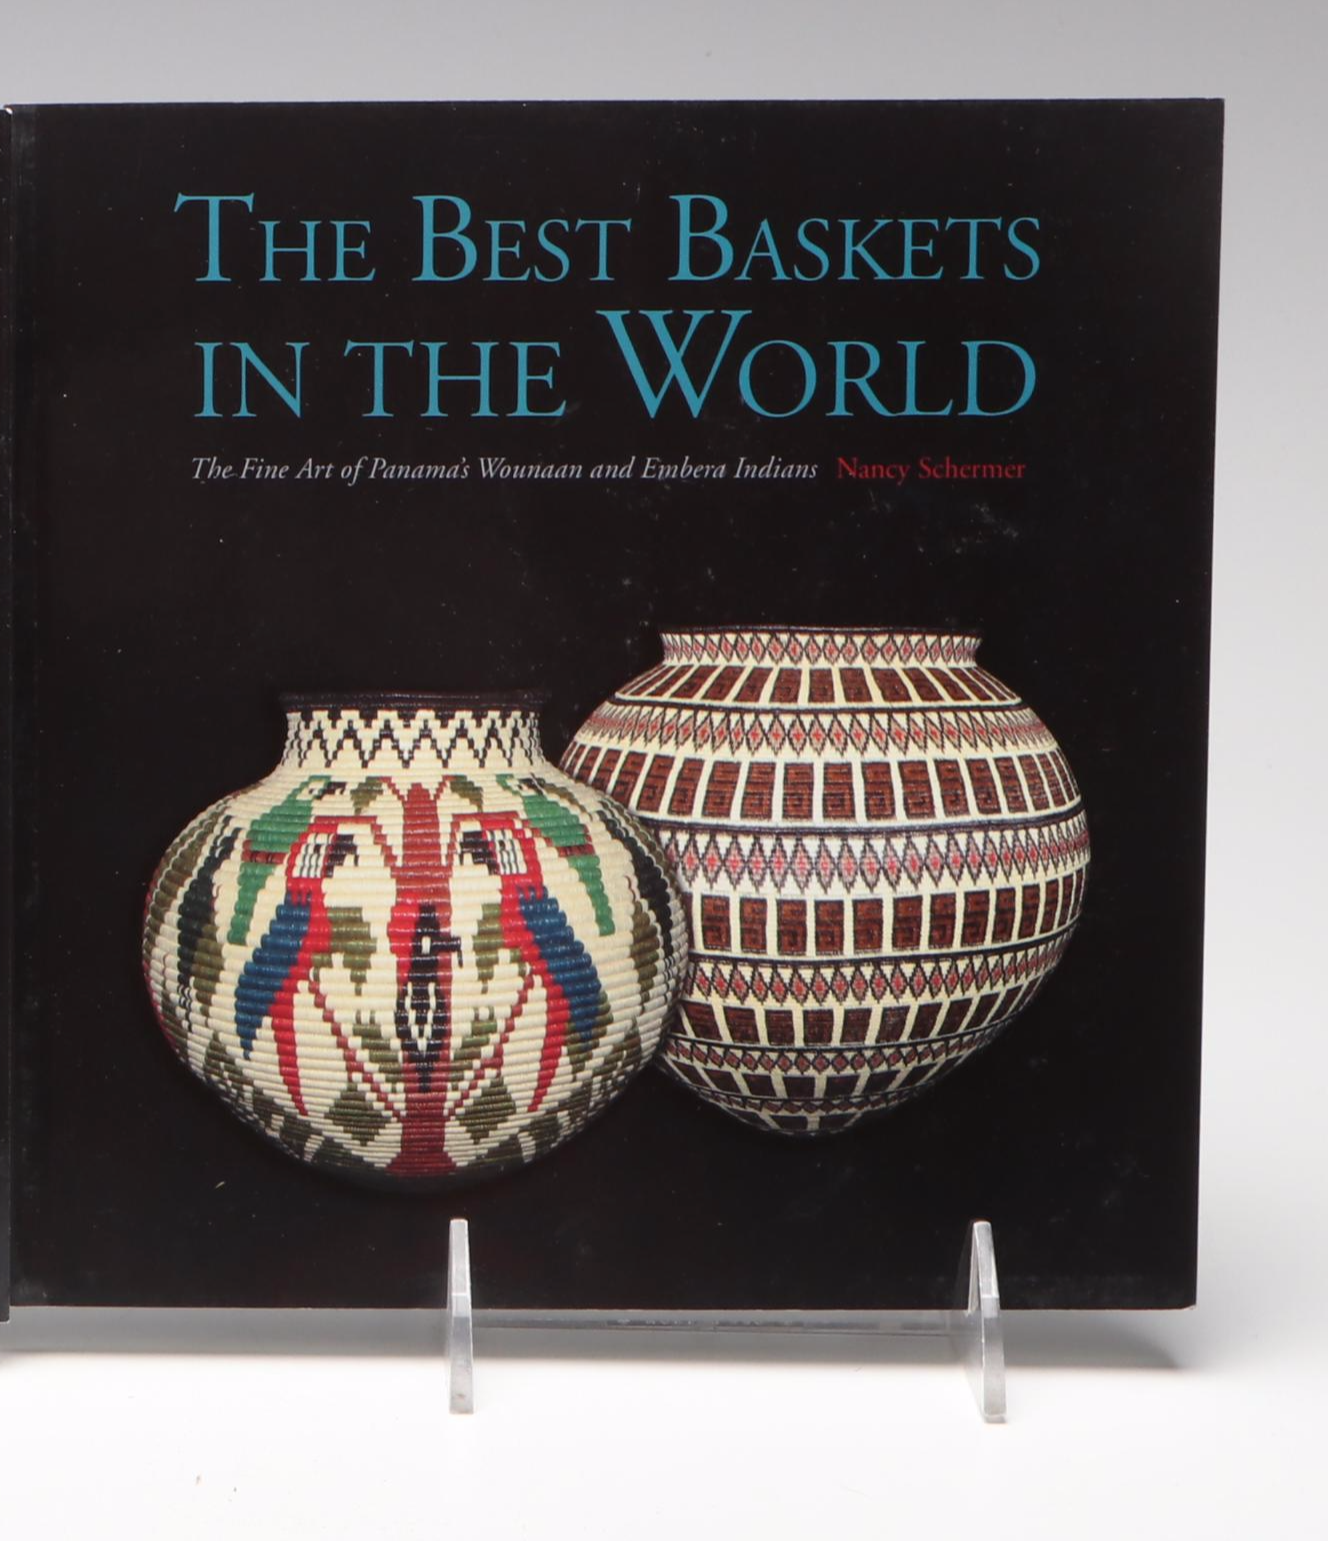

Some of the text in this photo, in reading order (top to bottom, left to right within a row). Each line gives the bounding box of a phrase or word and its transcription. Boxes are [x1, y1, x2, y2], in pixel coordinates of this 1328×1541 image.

[192, 455, 1025, 487] The Fine Art of Panama's Wounaan and Embera Indians Nancy Schermer
